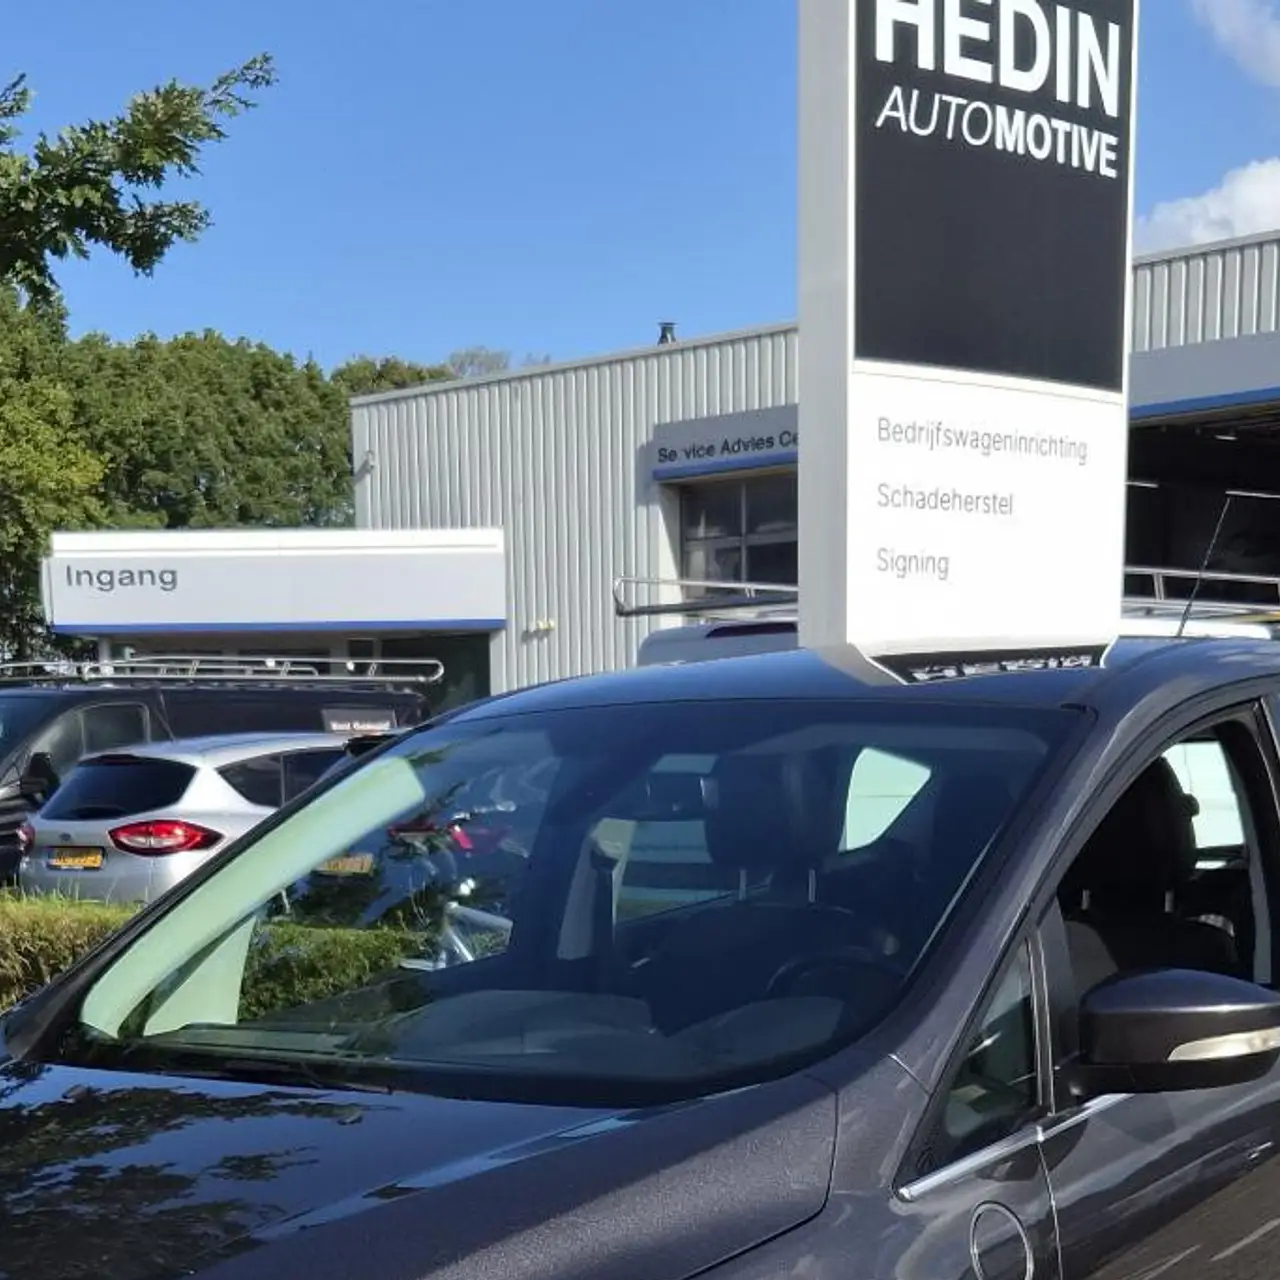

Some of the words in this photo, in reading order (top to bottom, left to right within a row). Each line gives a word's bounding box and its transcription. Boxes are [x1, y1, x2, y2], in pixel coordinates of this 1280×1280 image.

[875, 0, 1120, 117] HEDIN
[875, 85, 1118, 178] AUTOMOTIVE
[658, 442, 715, 462] Sevice
[720, 435, 773, 454] Advies
[877, 417, 1088, 466] Bedrijfswageninrichting
[877, 482, 1014, 515] Schadeherstel
[66, 565, 177, 591] Ingang
[877, 547, 950, 580] Signing
